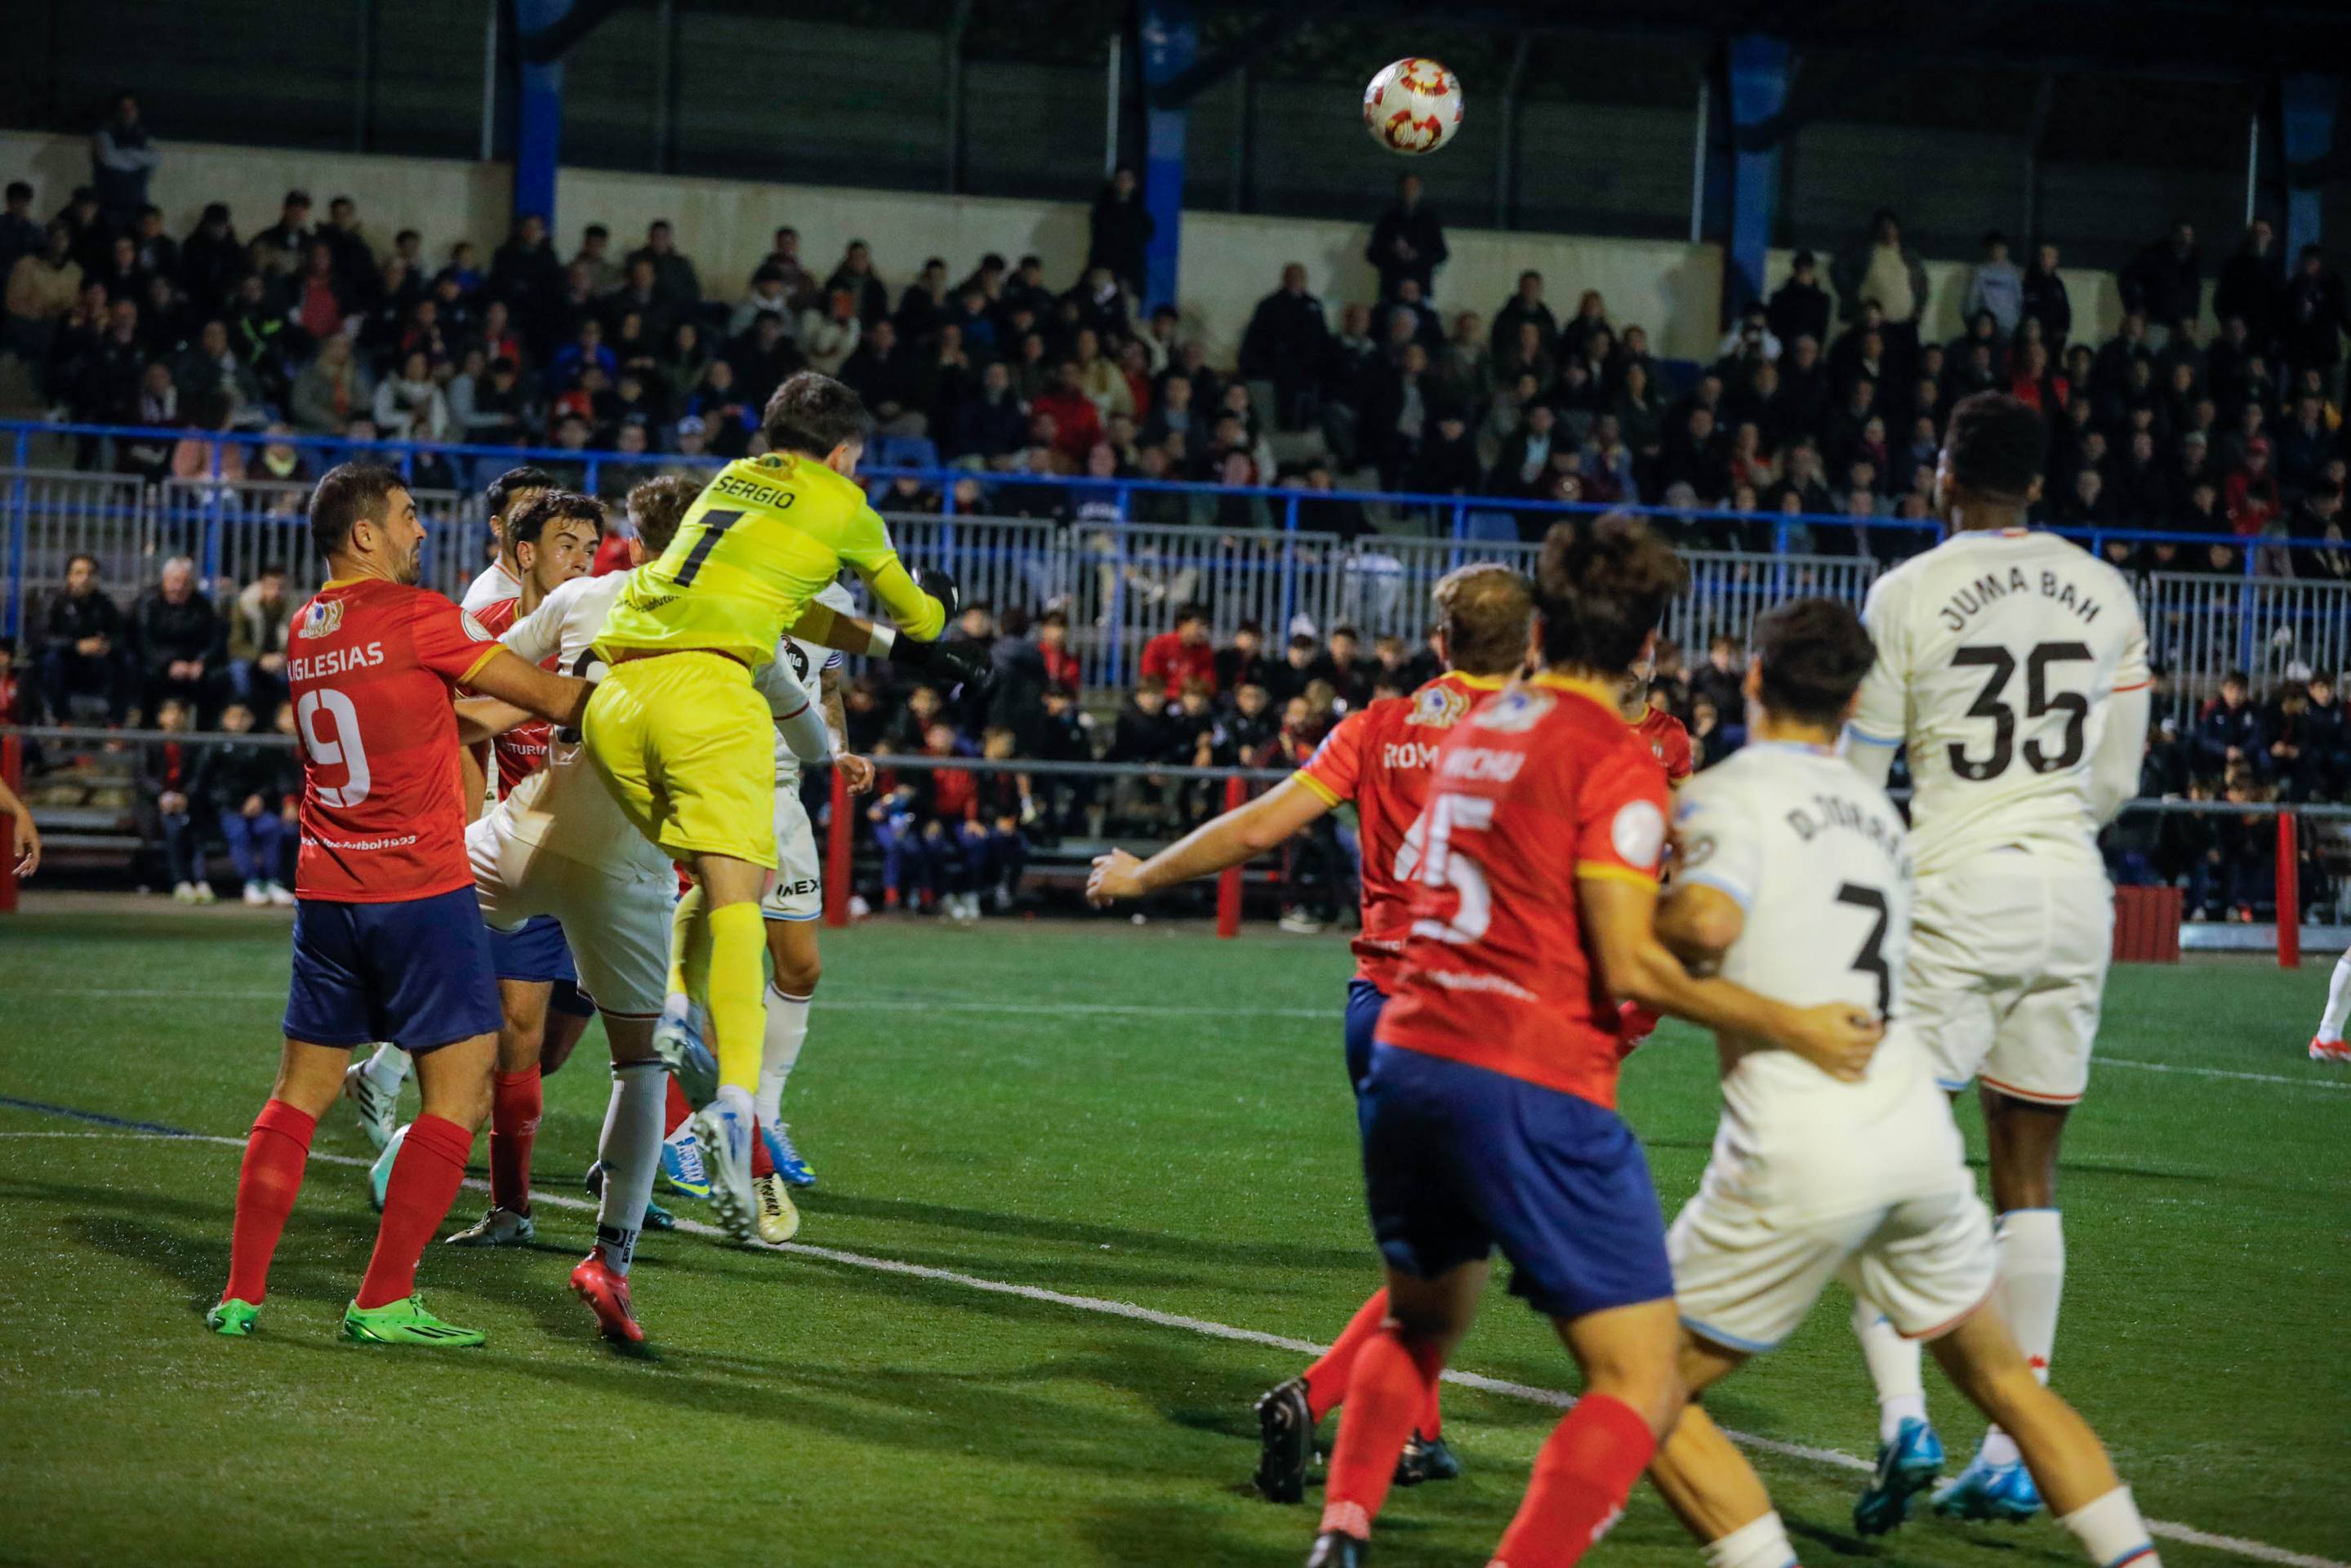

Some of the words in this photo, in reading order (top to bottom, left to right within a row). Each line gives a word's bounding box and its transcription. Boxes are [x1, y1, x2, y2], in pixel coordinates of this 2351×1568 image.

[713, 475, 795, 509] SERGIO
[1940, 566, 2028, 632] JUMA
[2042, 570, 2102, 624] BAH
[297, 688, 371, 808] 9
[1948, 642, 2094, 781] 35
[1413, 794, 1495, 944] 5
[1837, 883, 1890, 1024] 3
